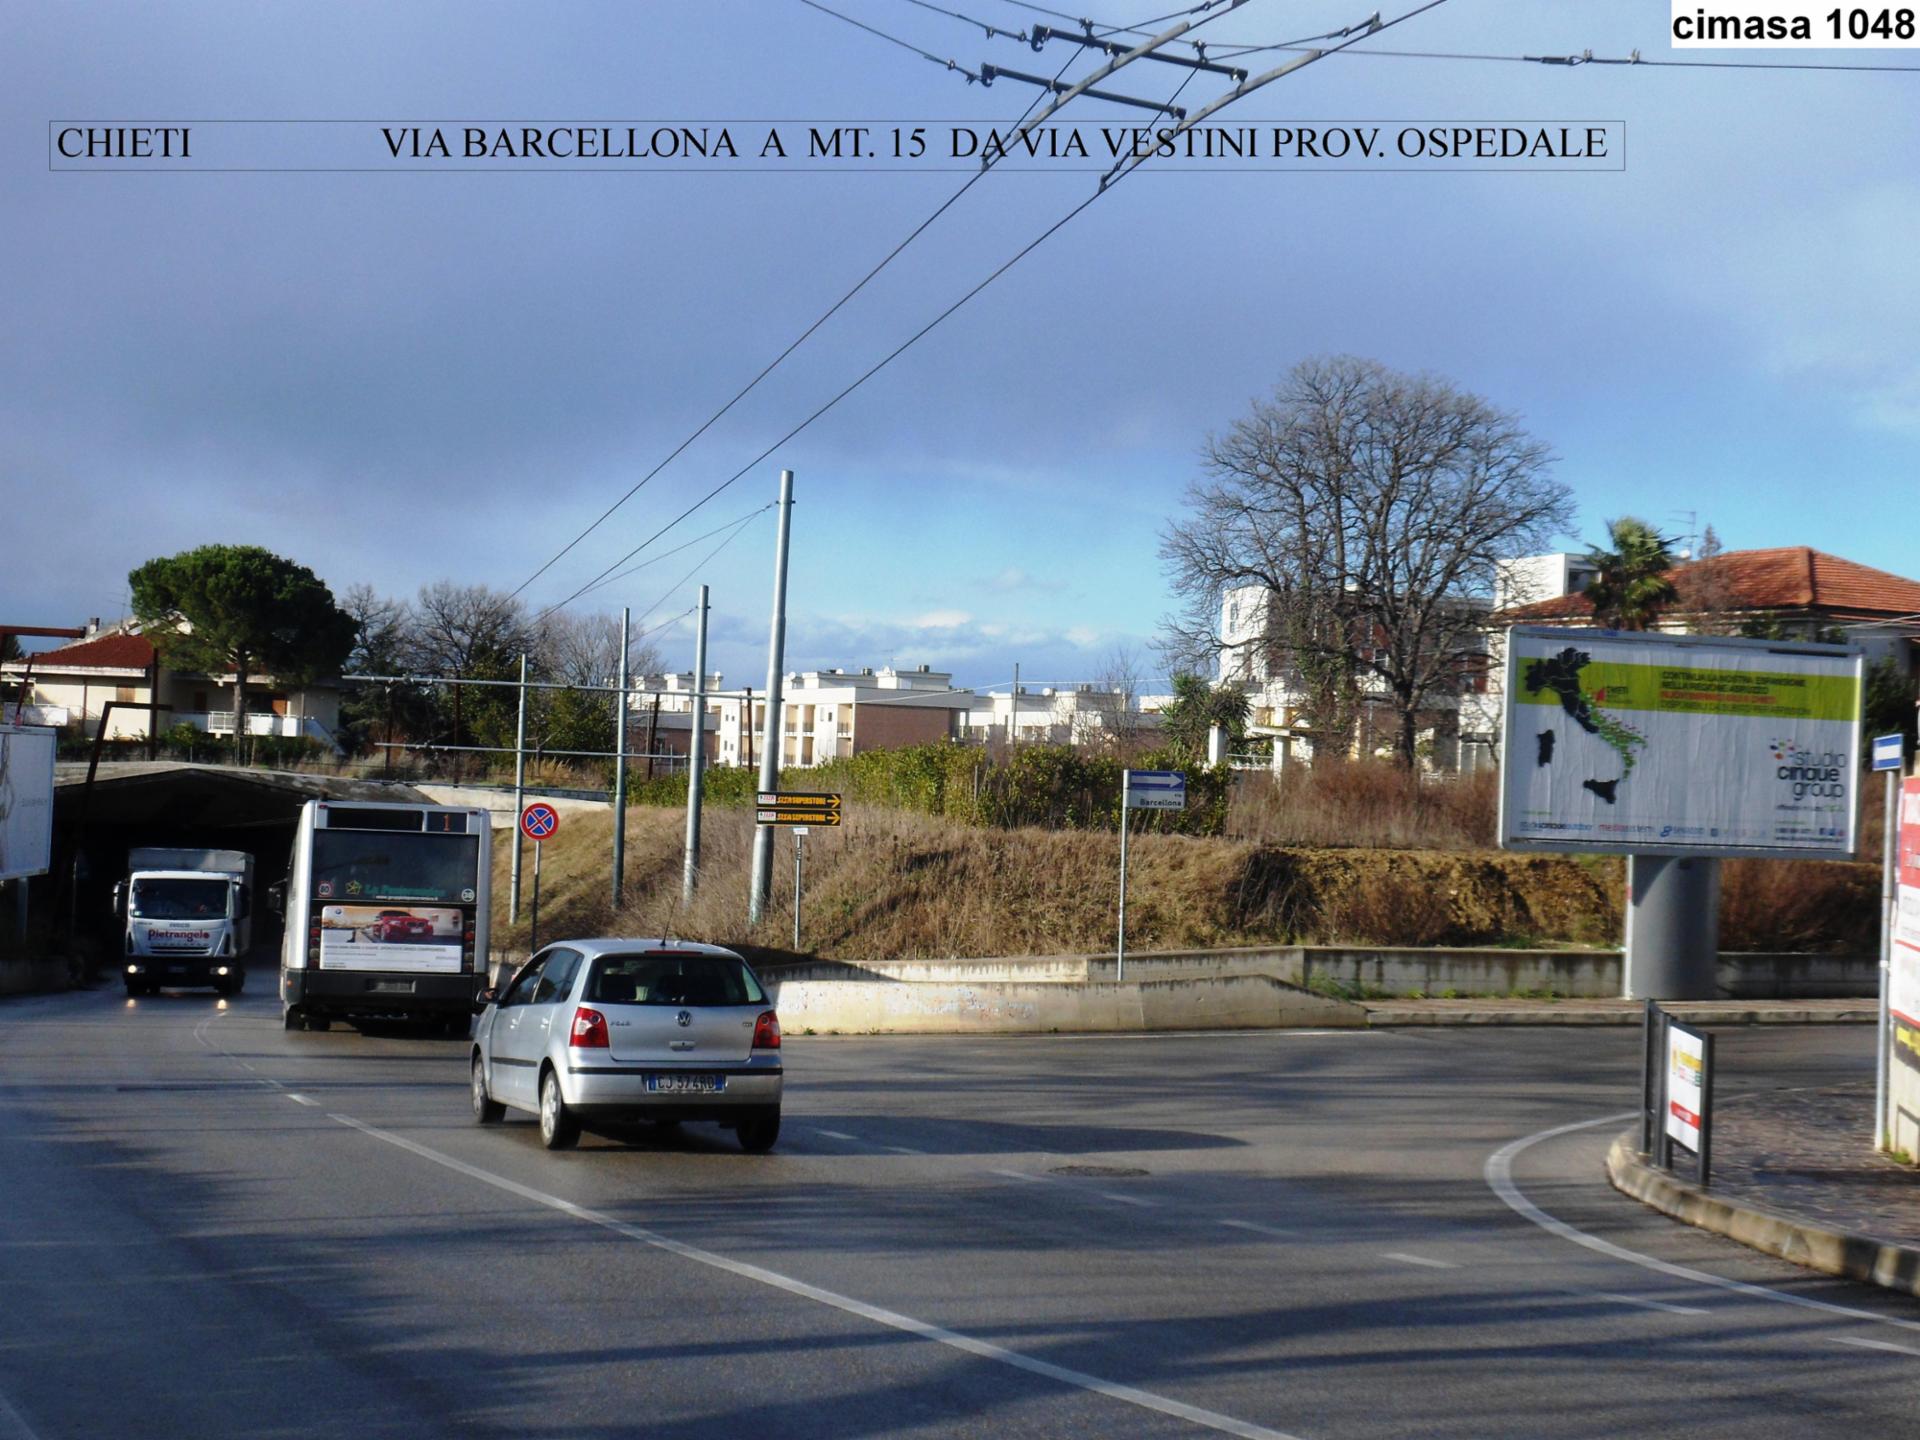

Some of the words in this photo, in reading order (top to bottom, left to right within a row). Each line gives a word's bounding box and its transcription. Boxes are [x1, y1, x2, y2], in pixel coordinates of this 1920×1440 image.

[1795, 749, 1846, 768] studio
[1777, 765, 1840, 782] cinque
[1793, 782, 1845, 801] group
[443, 814, 449, 832] 1
[147, 928, 211, 942] Pietrangelo
